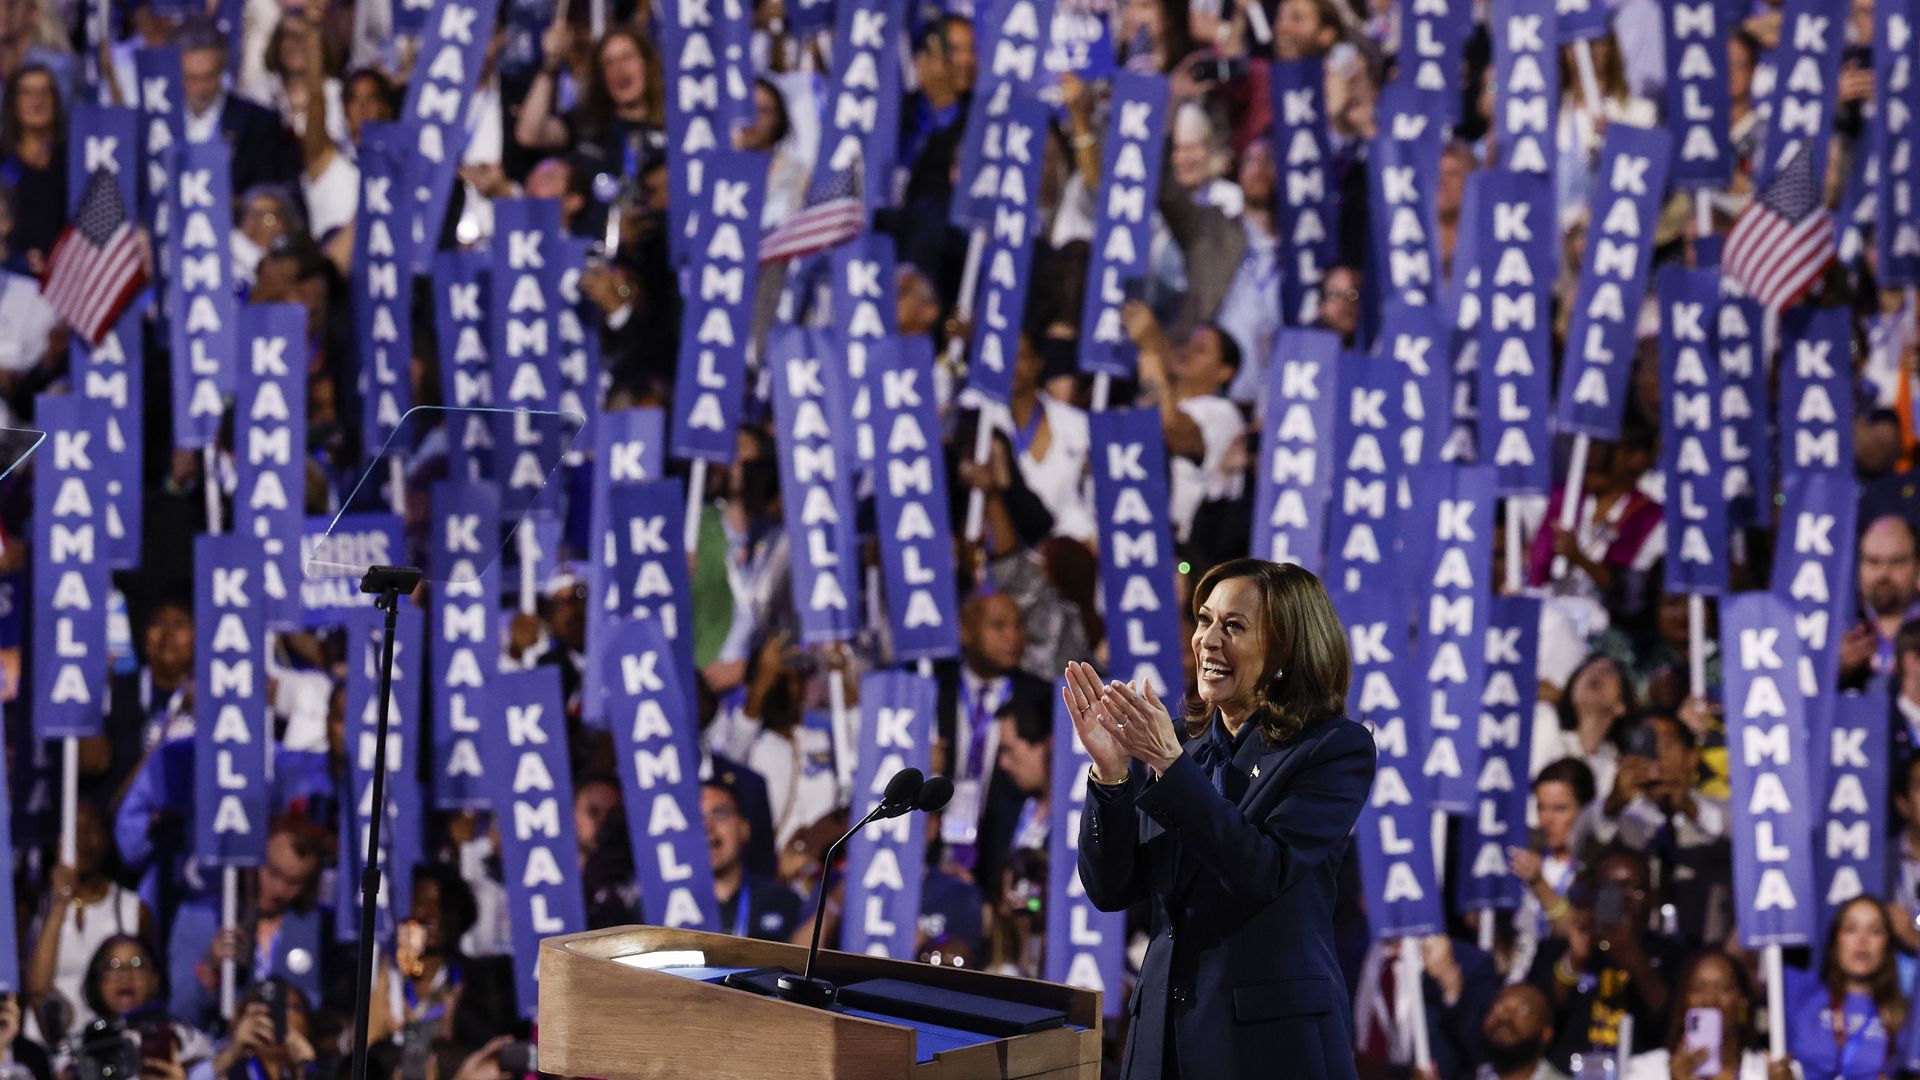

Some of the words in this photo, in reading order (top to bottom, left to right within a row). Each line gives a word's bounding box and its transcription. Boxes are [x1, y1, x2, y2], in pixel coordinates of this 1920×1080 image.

[1506, 14, 1548, 173] KAMA
[179, 169, 224, 418] KAMALA
[365, 176, 401, 428] KAMALA
[687, 179, 749, 432] KAMALA
[980, 121, 1033, 374] KAMALA
[1093, 100, 1152, 344] KAMALA
[1491, 202, 1536, 466] KAMALA
[1573, 152, 1651, 408] KAMALA
[506, 230, 549, 489] KAMALA
[786, 358, 847, 611] KAMALA
[1270, 361, 1321, 563] KAMAL
[1671, 301, 1713, 565] KAMALA
[1794, 339, 1840, 468] KAM
[50, 430, 95, 704] KAMALA
[882, 368, 943, 629] KAMALA
[210, 567, 252, 834] KAMALA
[443, 514, 486, 777] KAMALA
[1422, 499, 1476, 778] KAMALA
[1471, 626, 1523, 879] KAMALA
[505, 703, 565, 936] KAMAL
[620, 650, 705, 928] KAMALA
[1739, 627, 1798, 911] KAMALA
[1826, 727, 1871, 906] KAMA
